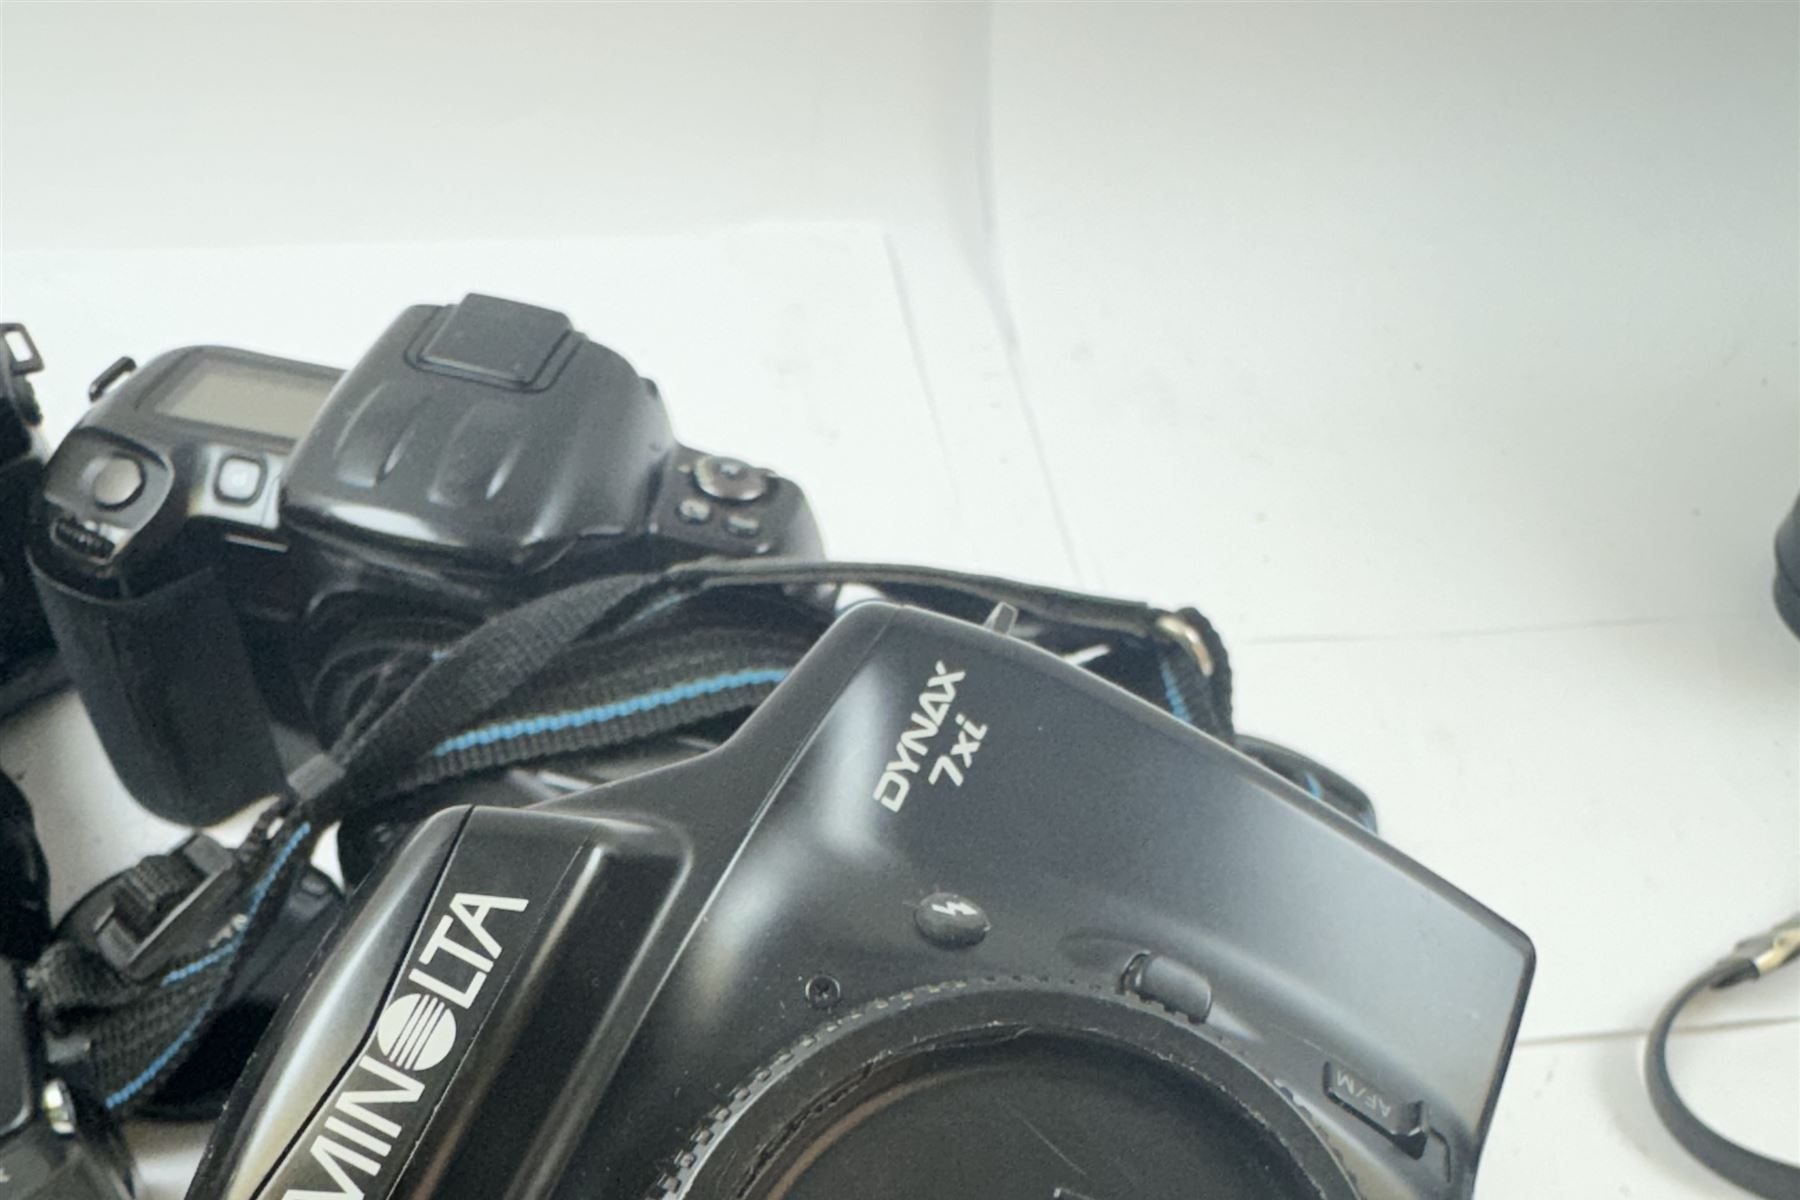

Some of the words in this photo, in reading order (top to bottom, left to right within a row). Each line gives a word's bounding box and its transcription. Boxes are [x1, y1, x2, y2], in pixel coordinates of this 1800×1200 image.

[873, 660, 966, 813] DYNAX
[928, 713, 988, 787] 7xi
[1337, 1069, 1391, 1118] AF/M
